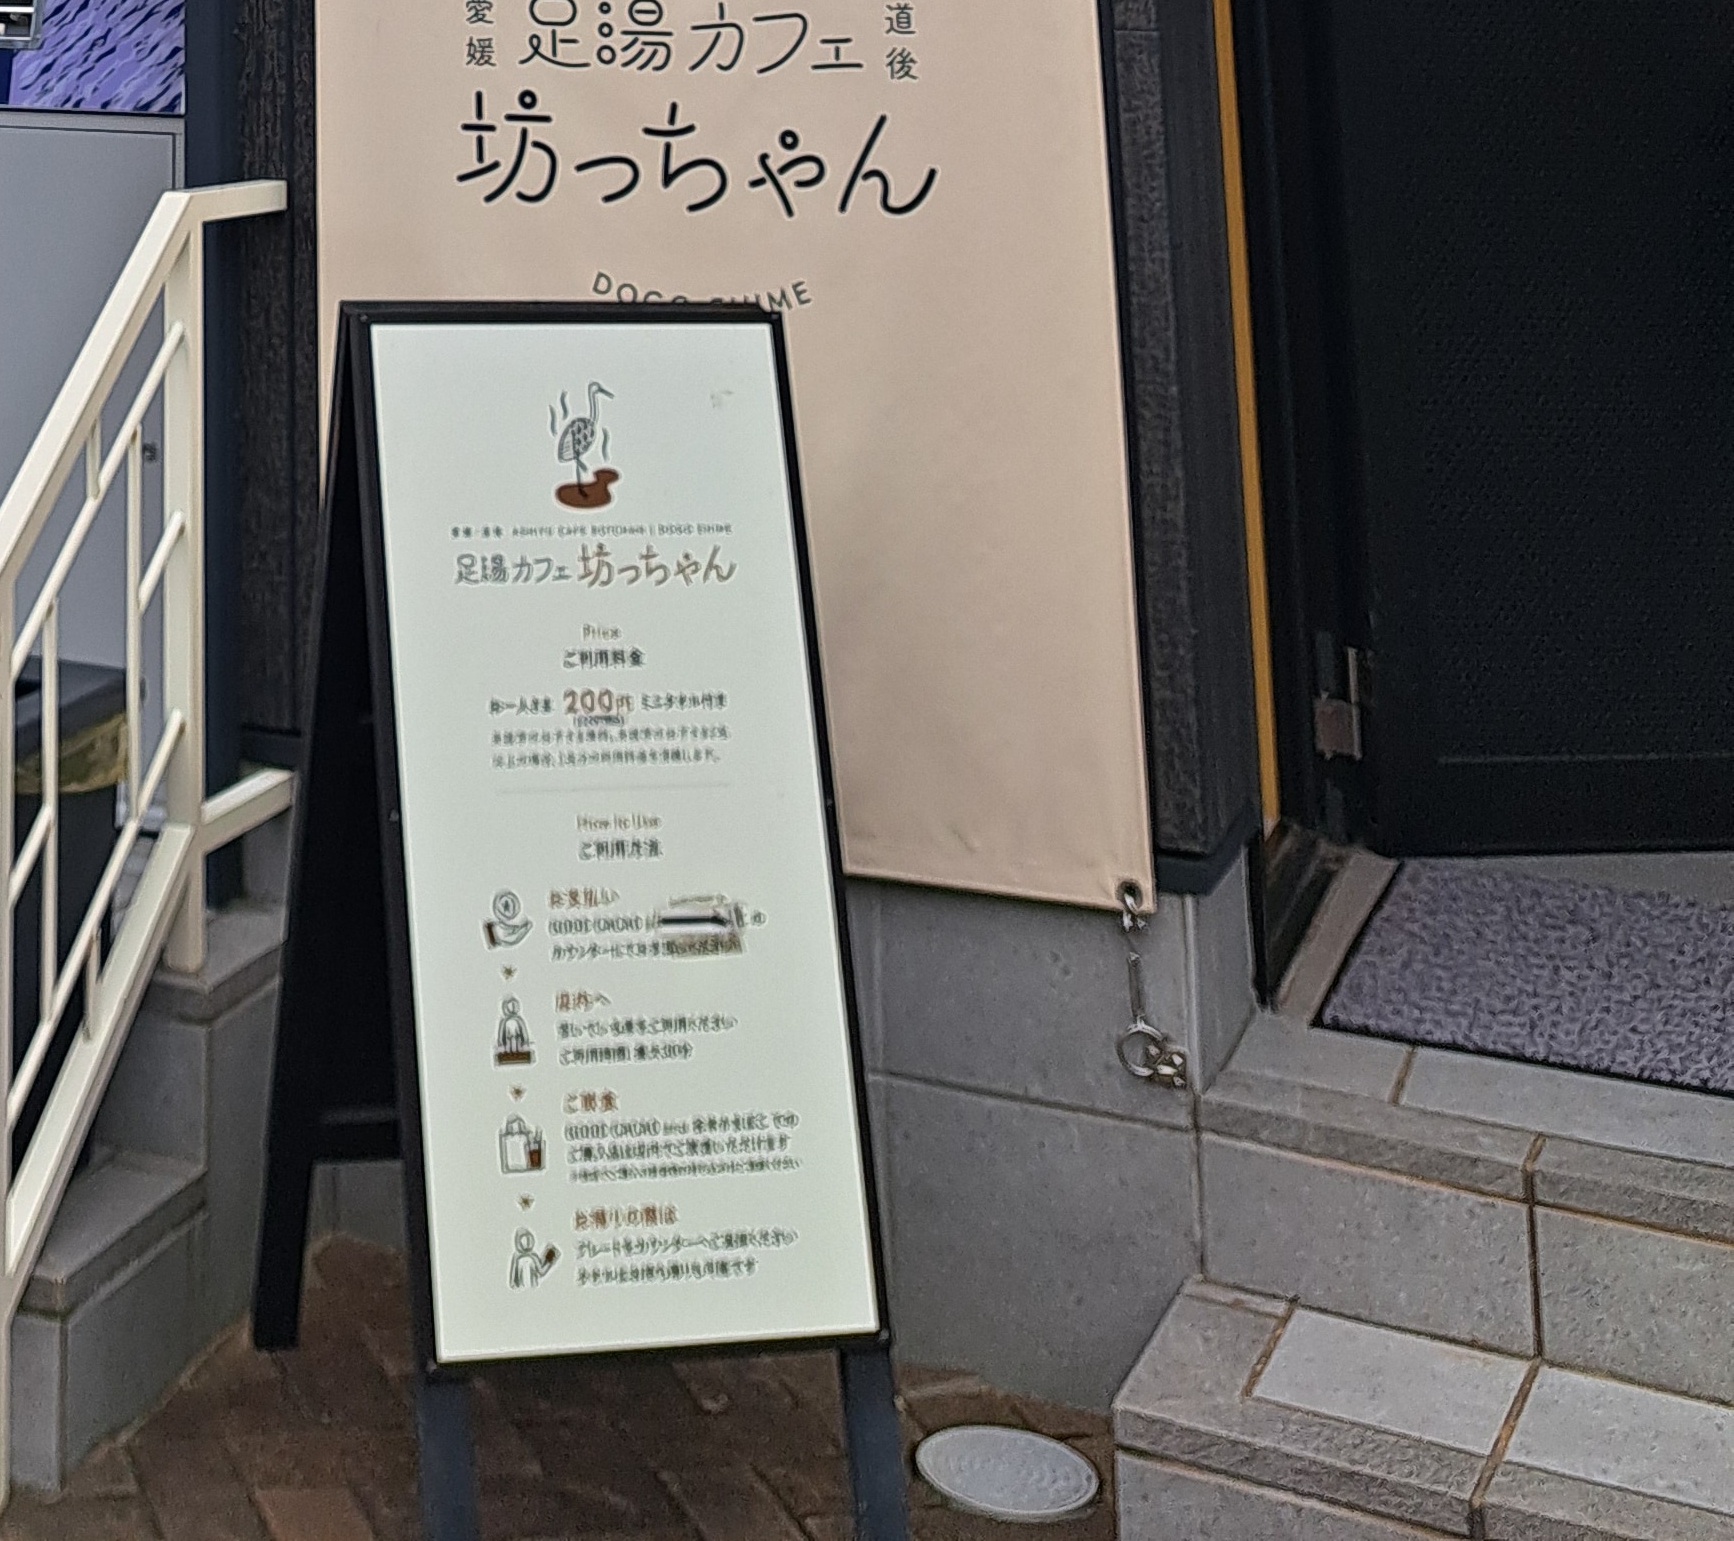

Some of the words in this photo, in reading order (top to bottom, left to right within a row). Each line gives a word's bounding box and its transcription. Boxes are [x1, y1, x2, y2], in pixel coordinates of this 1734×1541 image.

[884, 2, 920, 82] 道後
[455, 88, 939, 218] 坊っちゃん
[454, 552, 574, 585] 足湯カフェ
[576, 541, 738, 588] 坊っちゃん
